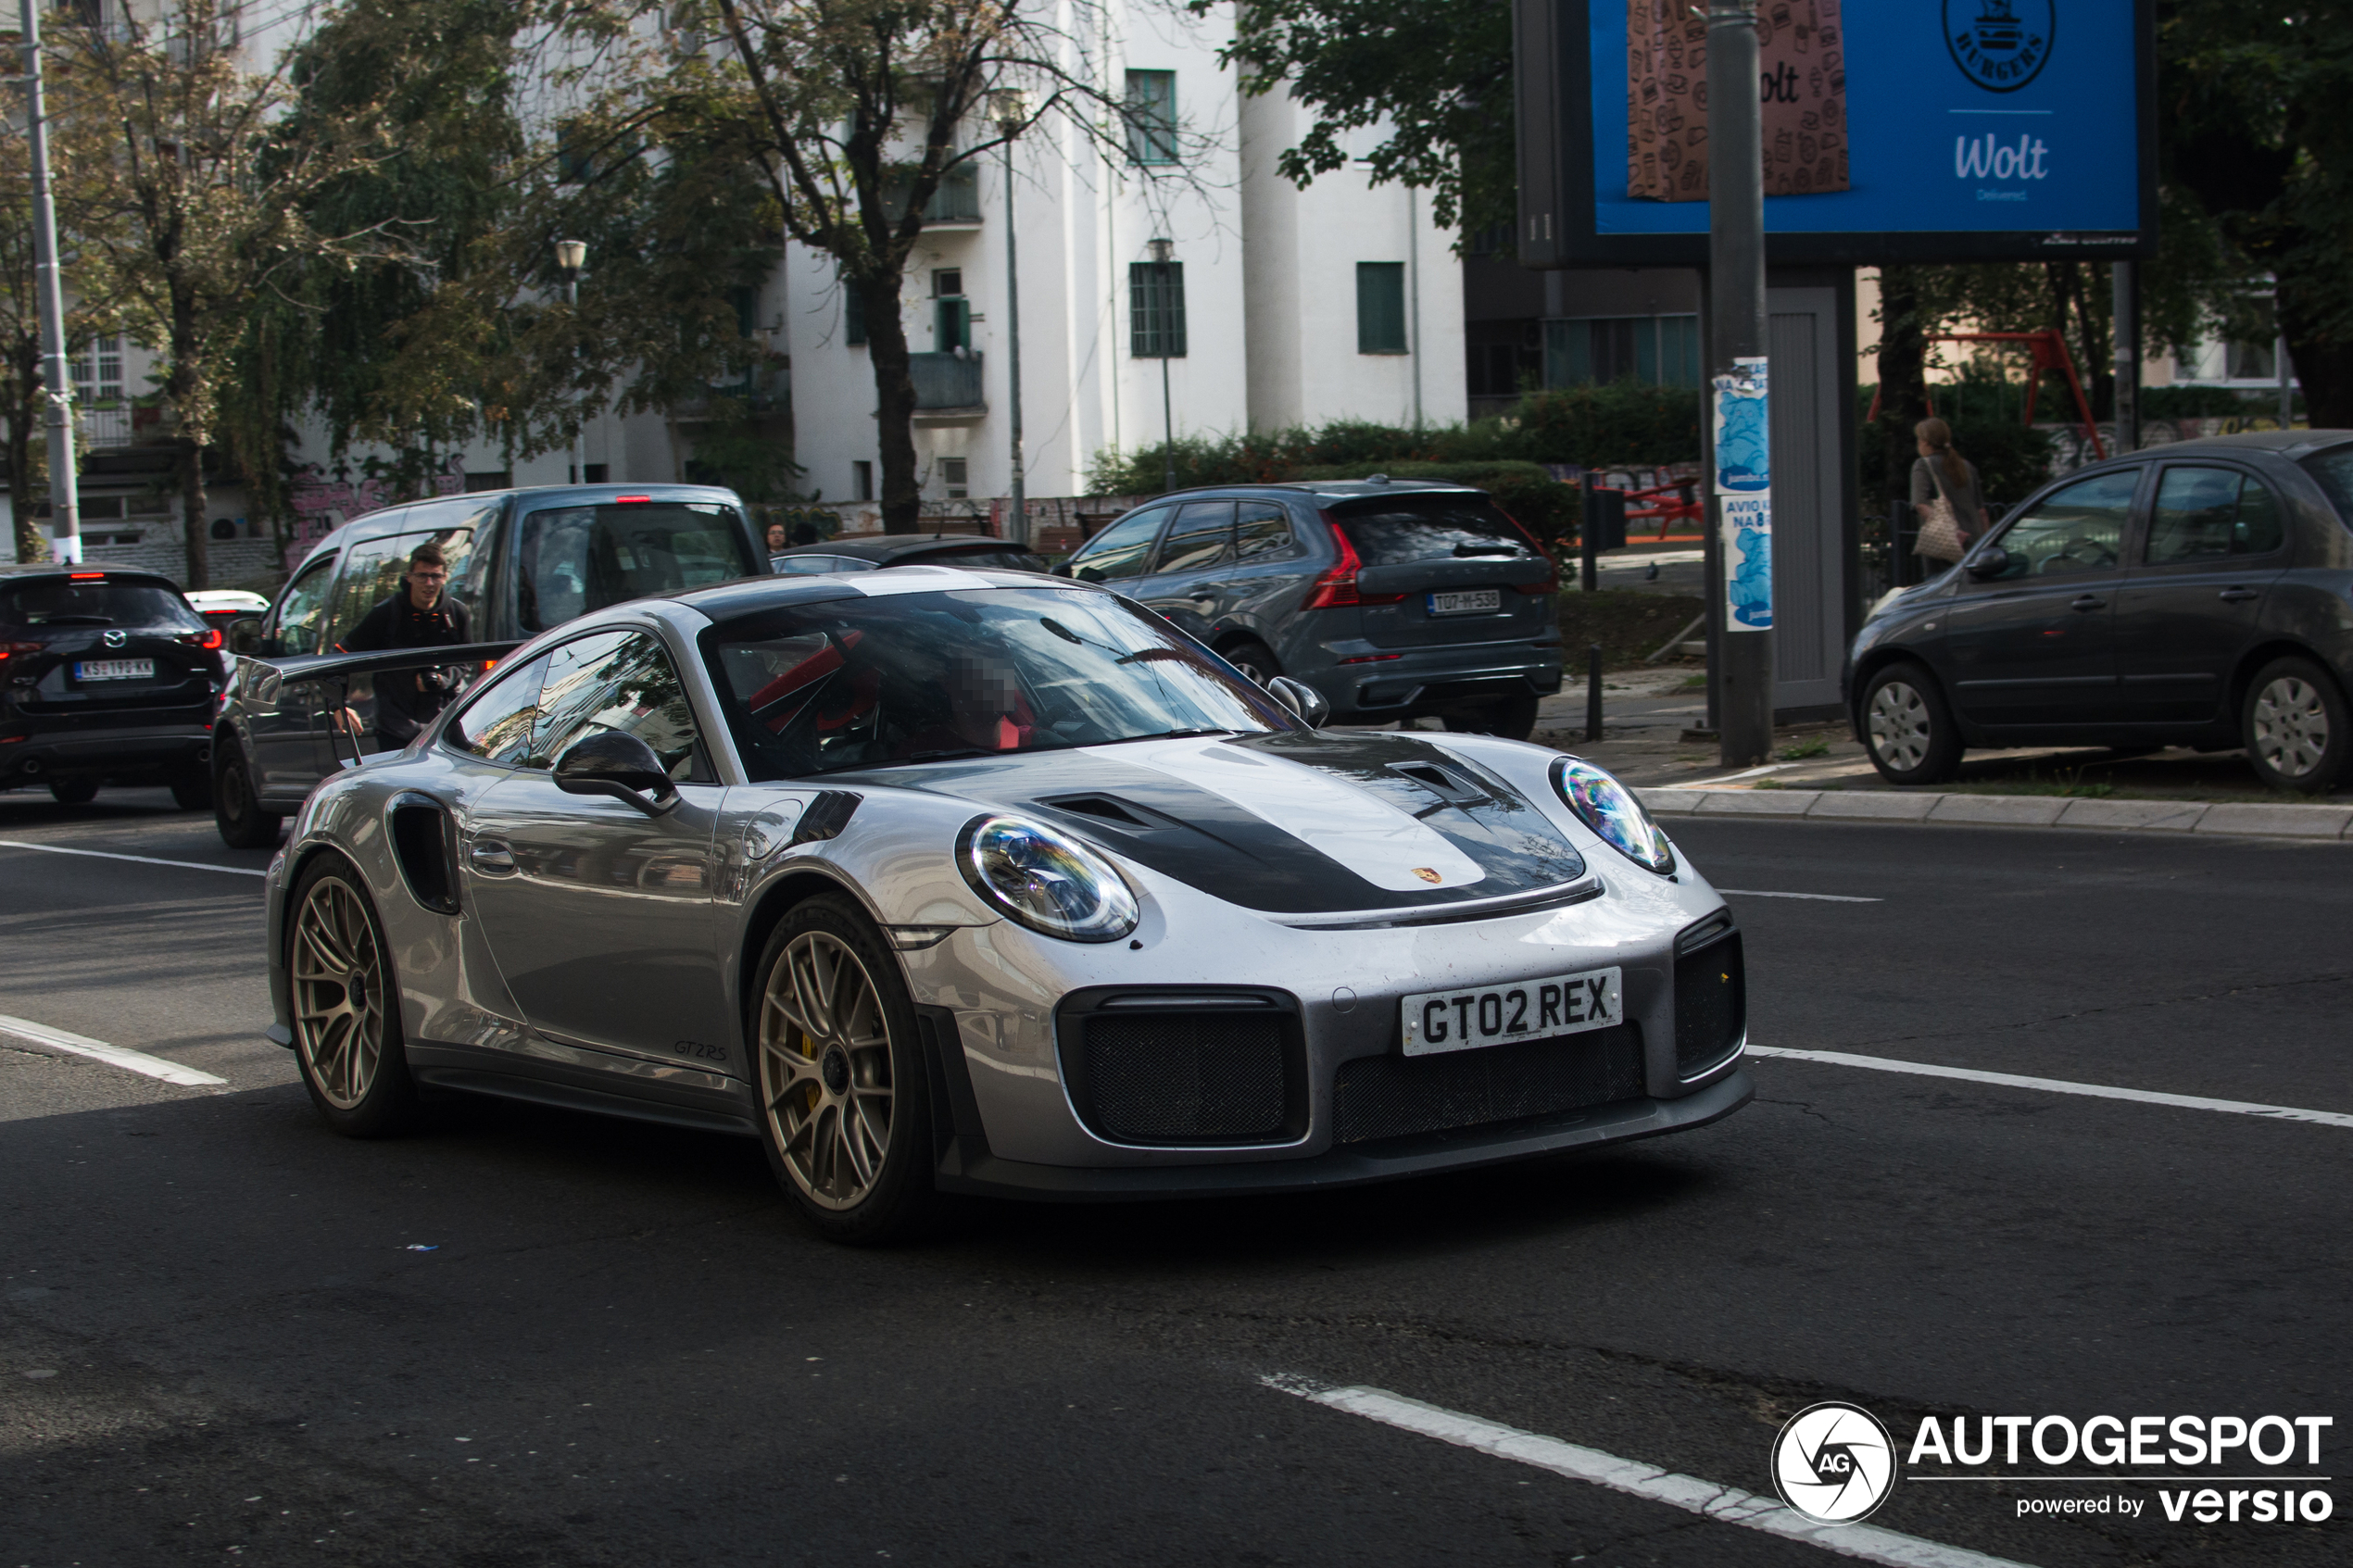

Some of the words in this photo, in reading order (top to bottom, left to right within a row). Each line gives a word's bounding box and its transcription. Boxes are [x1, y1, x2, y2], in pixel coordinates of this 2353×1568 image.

[1956, 31, 2044, 82] BURGERS
[1760, 60, 1800, 104] olt
[1956, 132, 2049, 180] Wolt
[1726, 500, 1759, 513] AVIO
[1733, 516, 1754, 528] NA
[1756, 511, 1765, 527] 8
[1423, 988, 1529, 1044] GT02
[1540, 975, 1607, 1029] REX
